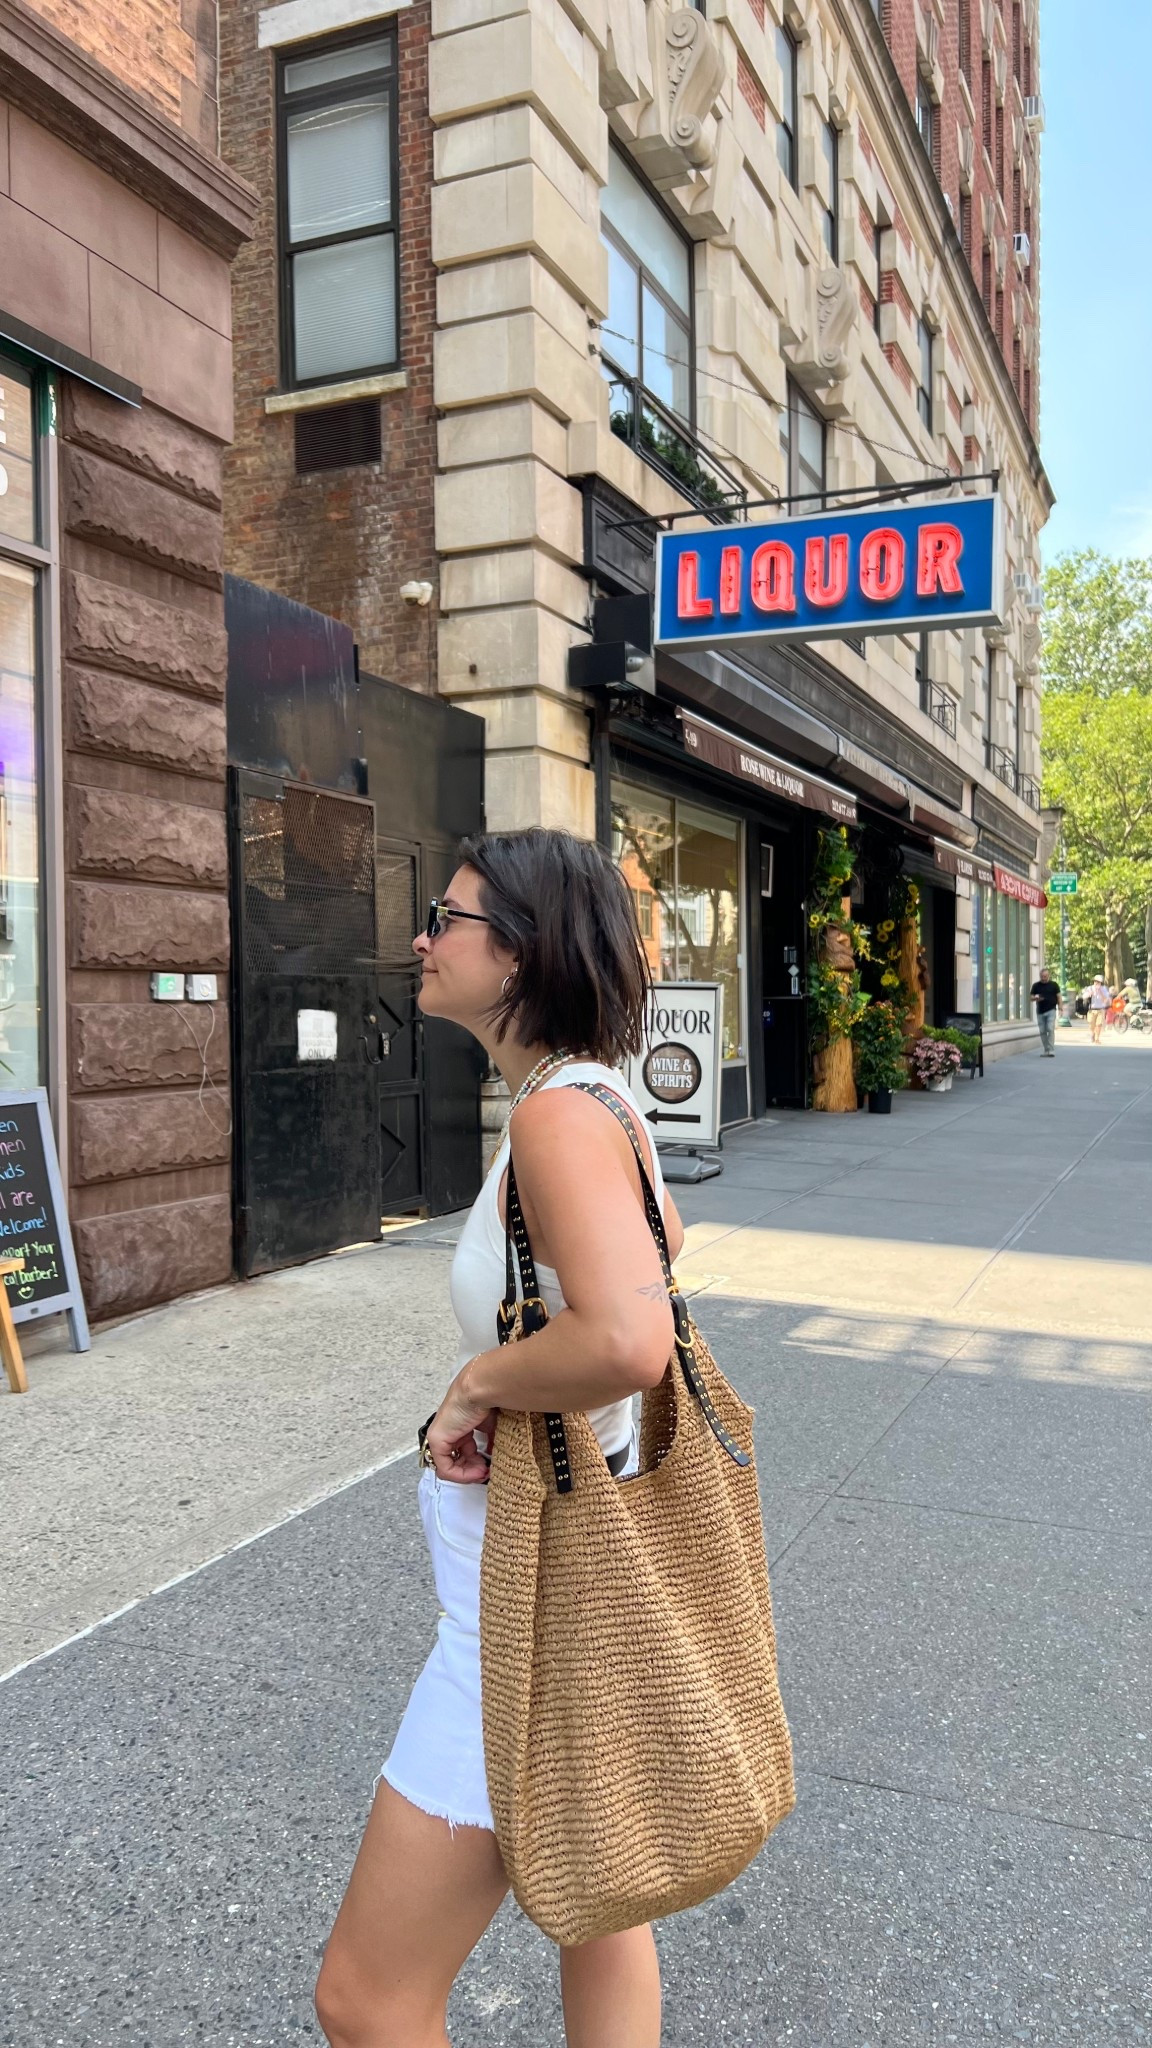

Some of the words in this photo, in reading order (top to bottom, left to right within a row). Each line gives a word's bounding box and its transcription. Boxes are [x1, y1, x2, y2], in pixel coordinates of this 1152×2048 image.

[677, 522, 965, 618] LIQUOR
[740, 754, 760, 778] ROSE
[759, 763, 776, 786] WINE
[782, 773, 804, 798] LIQUOR
[652, 1057, 680, 1072] WINE
[683, 1058, 692, 1072] &
[651, 1074, 693, 1088] SPIRITS
[10, 1190, 36, 1206] are
